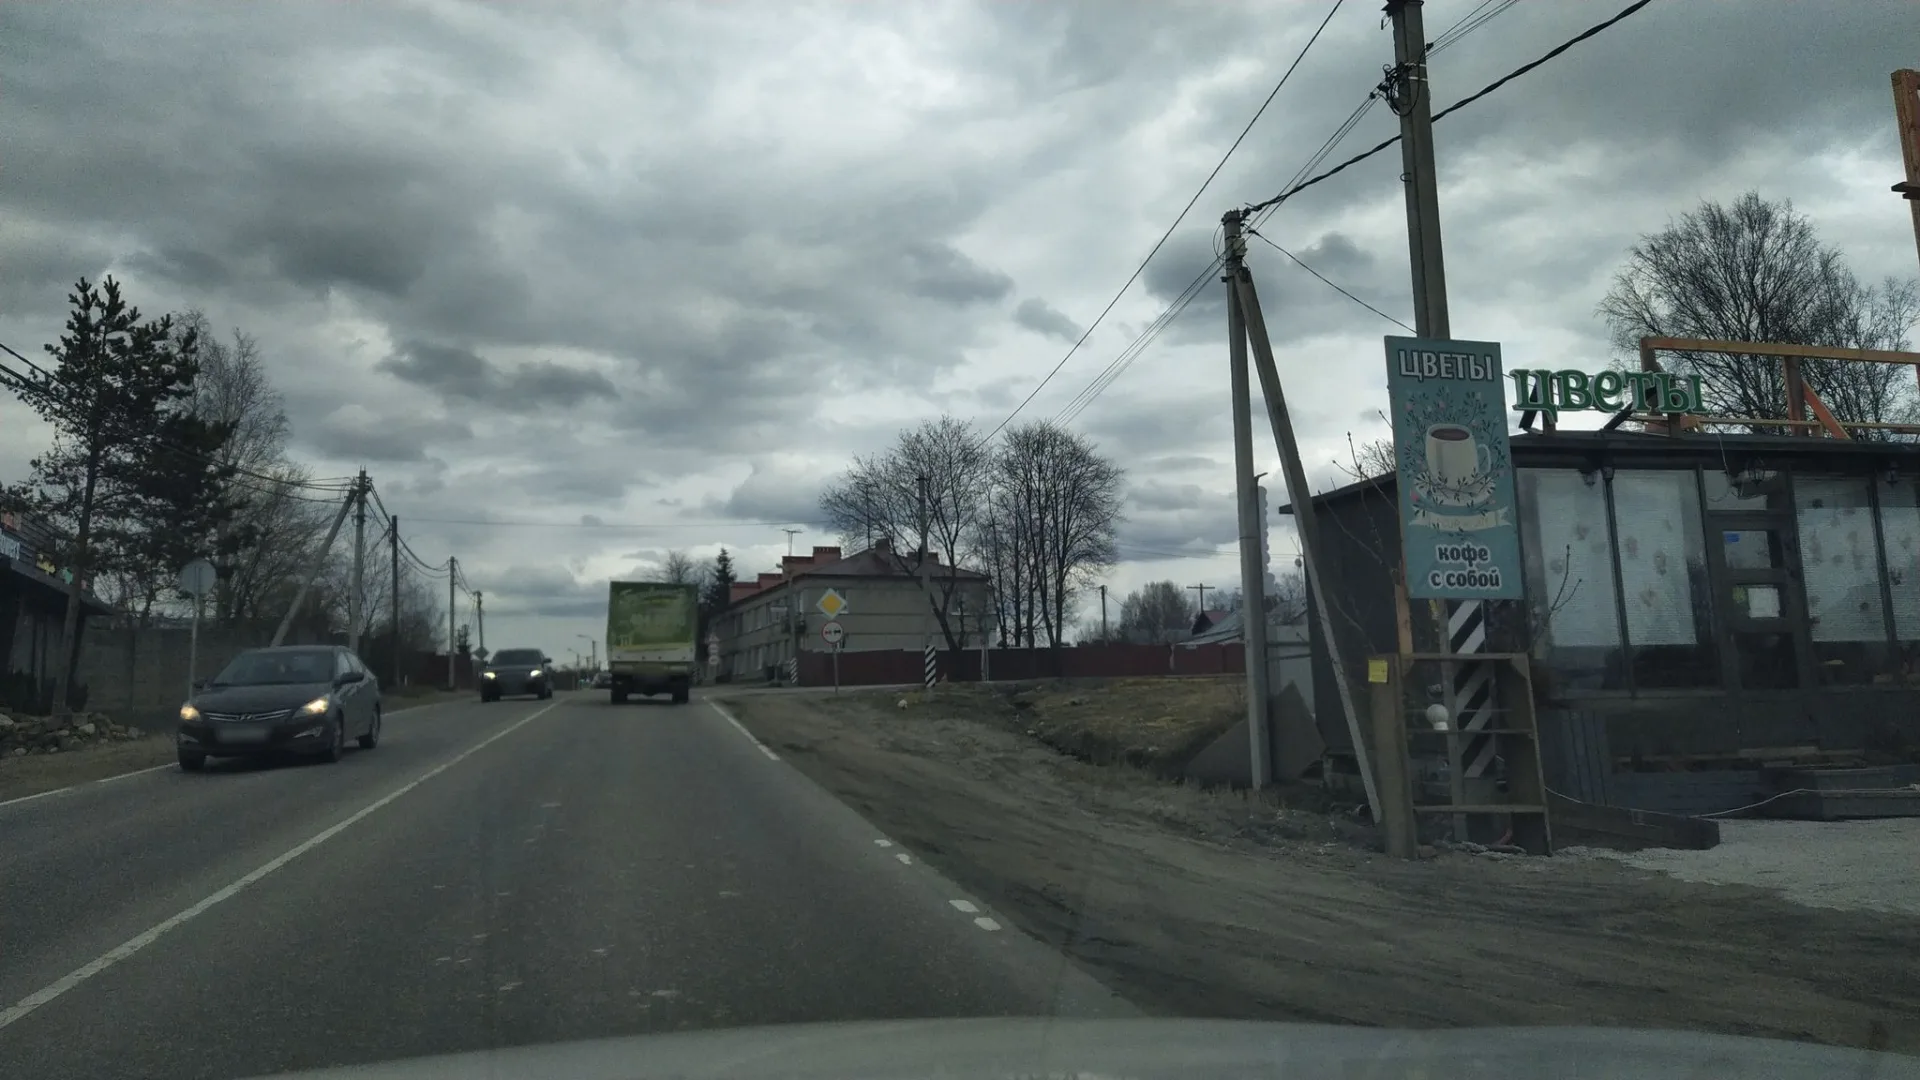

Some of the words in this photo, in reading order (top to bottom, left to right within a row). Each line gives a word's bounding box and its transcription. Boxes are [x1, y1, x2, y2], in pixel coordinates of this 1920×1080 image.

[1398, 350, 1494, 382] ЦВЕТЫ
[1437, 543, 1490, 568] кофе
[1430, 572, 1442, 587] с
[1445, 569, 1500, 588] собой
